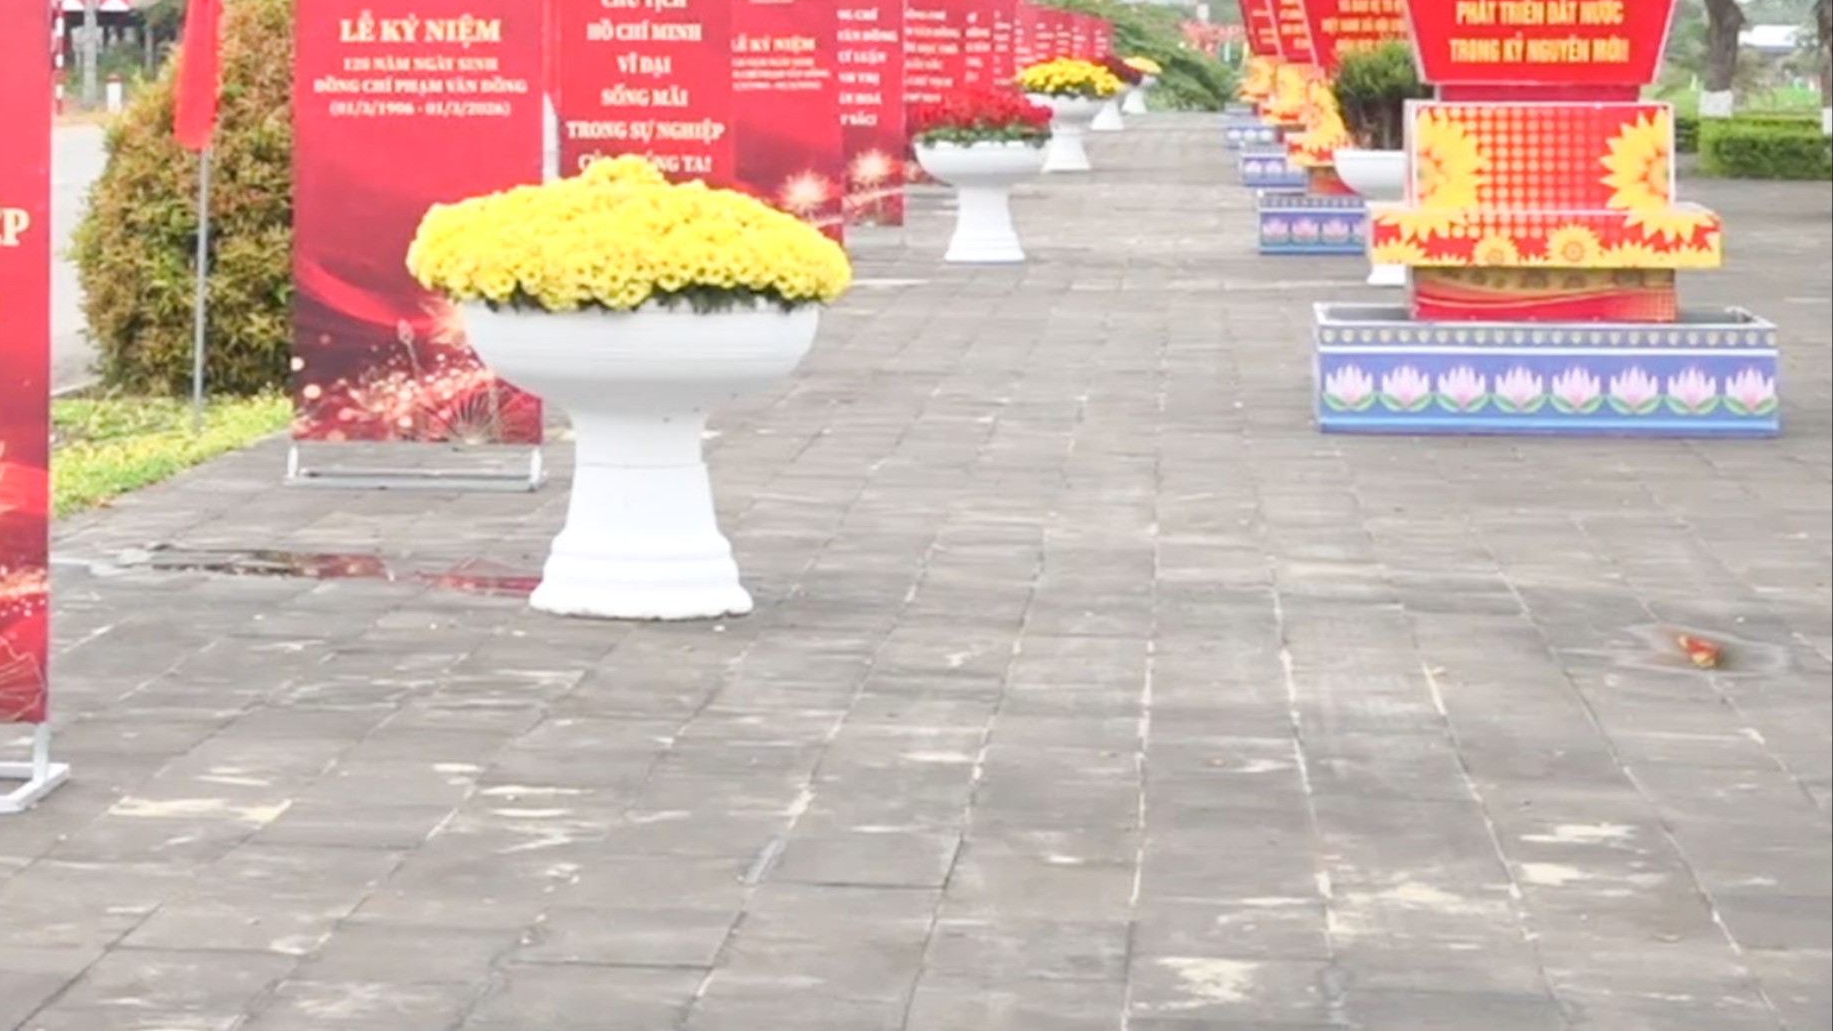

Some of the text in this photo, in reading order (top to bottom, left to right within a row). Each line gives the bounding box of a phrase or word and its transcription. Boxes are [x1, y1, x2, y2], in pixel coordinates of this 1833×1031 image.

[339, 9, 502, 50] LỄ KỶ NIỆM
[587, 18, 702, 41] HỒ CHÍ MINH
[1449, 39, 1500, 62] TRONG
[1526, 35, 1590, 62] NGUYÊN
[640, 56, 671, 78] ĐẠI
[362, 75, 392, 94] CHÍ
[394, 78, 444, 97] PHẠM
[601, 83, 688, 107] SỐNG MÃI
[566, 117, 725, 145] TRONG SỰ NGHIỆP
[681, 155, 712, 172] TA!
